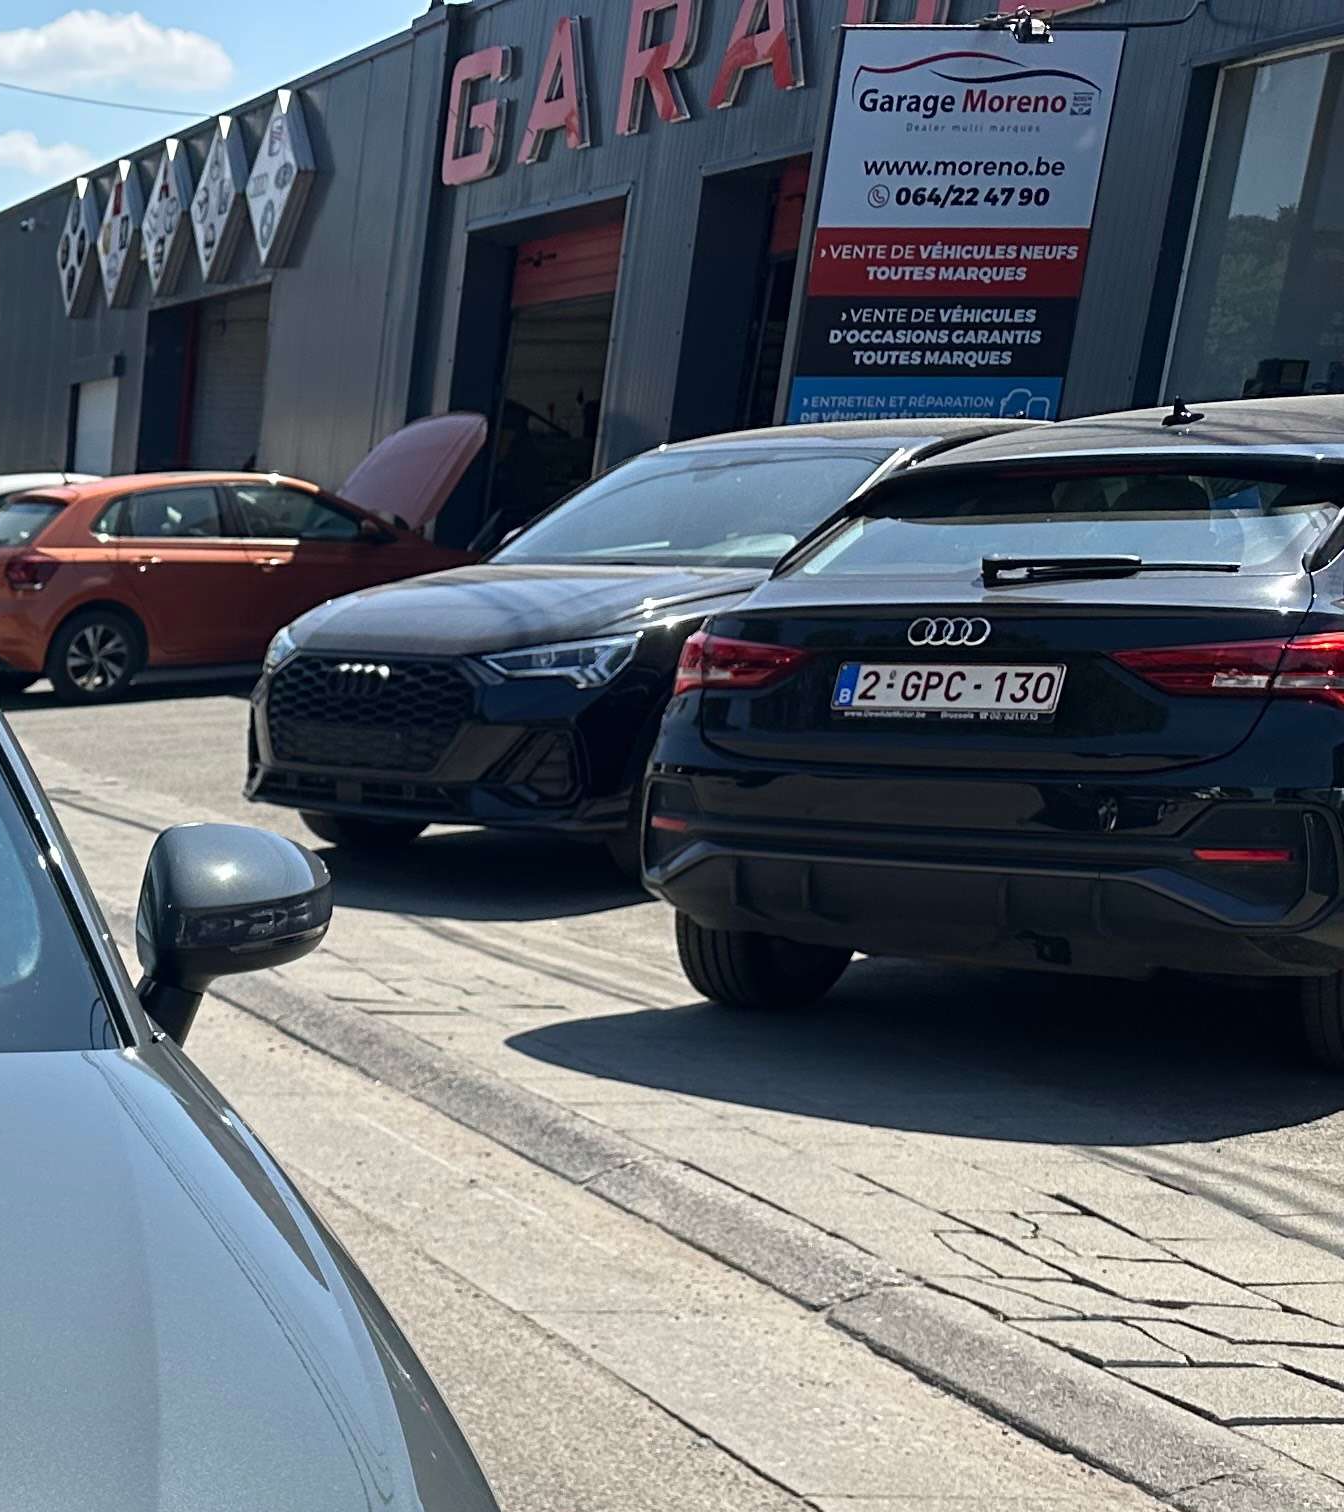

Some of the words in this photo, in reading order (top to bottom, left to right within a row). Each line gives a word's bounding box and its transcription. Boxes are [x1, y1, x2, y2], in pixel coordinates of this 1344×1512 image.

[859, 88, 956, 118] Garage
[961, 89, 1067, 113] Moreno
[905, 122, 946, 133] Dealer
[951, 122, 984, 133] multi
[989, 123, 1041, 134] marques
[863, 157, 1066, 177] www.moreno.be
[895, 185, 979, 208] 064/22
[983, 187, 1016, 207] 47
[1018, 187, 1051, 207] 90
[829, 245, 887, 260] VENTE
[890, 245, 917, 260] DE
[918, 241, 1018, 260] VÉHICULES
[1019, 245, 1079, 260] NEUFS
[866, 266, 937, 281] TOUTES
[938, 266, 1028, 284] MARQUES
[849, 308, 908, 323] VENTE
[910, 308, 937, 323] DE
[938, 305, 1037, 323] VÉHICULES
[828, 330, 949, 345] D'OCCASIONS
[951, 330, 1042, 345] GARANTIS
[852, 351, 921, 365] TOUTES
[923, 351, 1012, 368] MARQUES
[811, 395, 885, 408] ENTRETIEN
[888, 395, 907, 408] ET
[908, 394, 994, 408] RÉPARATION
